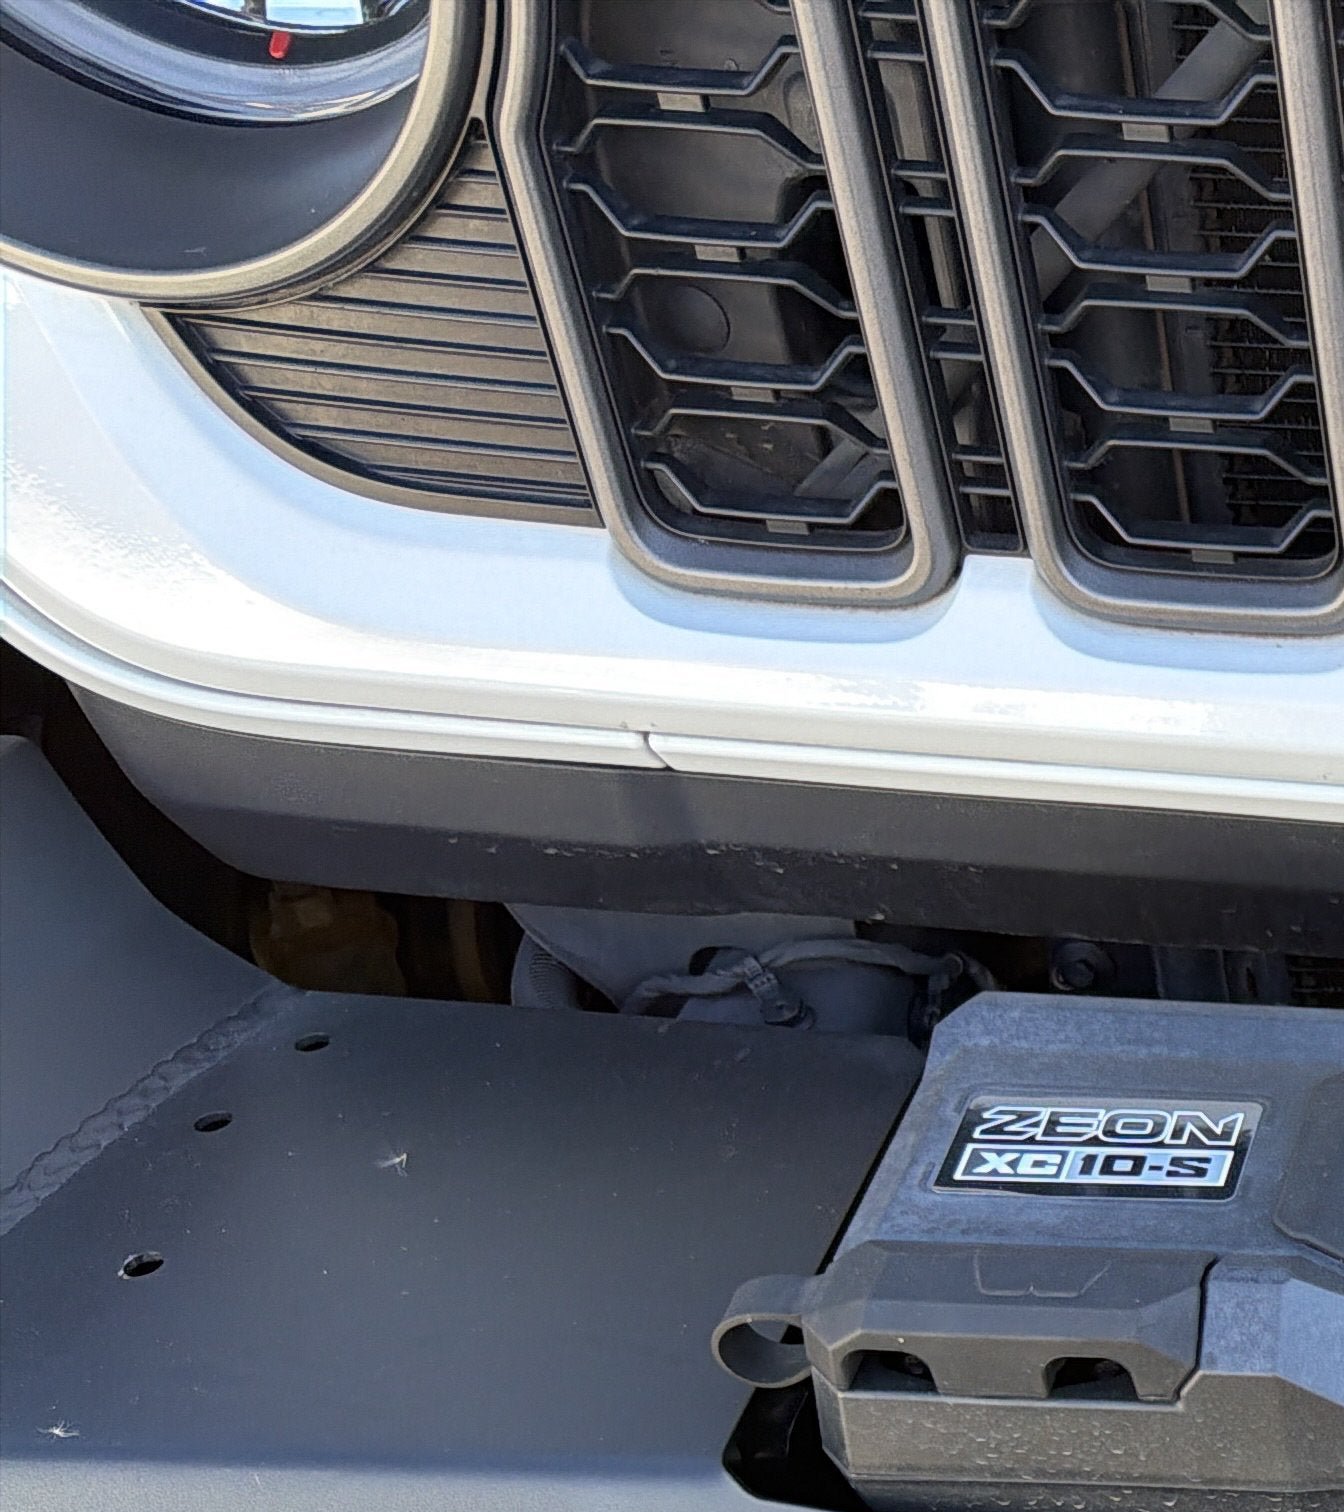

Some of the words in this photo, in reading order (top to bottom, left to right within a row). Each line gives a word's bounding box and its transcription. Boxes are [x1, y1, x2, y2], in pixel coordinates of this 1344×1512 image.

[973, 1106, 1245, 1147] ZEON
[971, 1151, 1062, 1177] XC
[1077, 1153, 1213, 1179] 10-S
